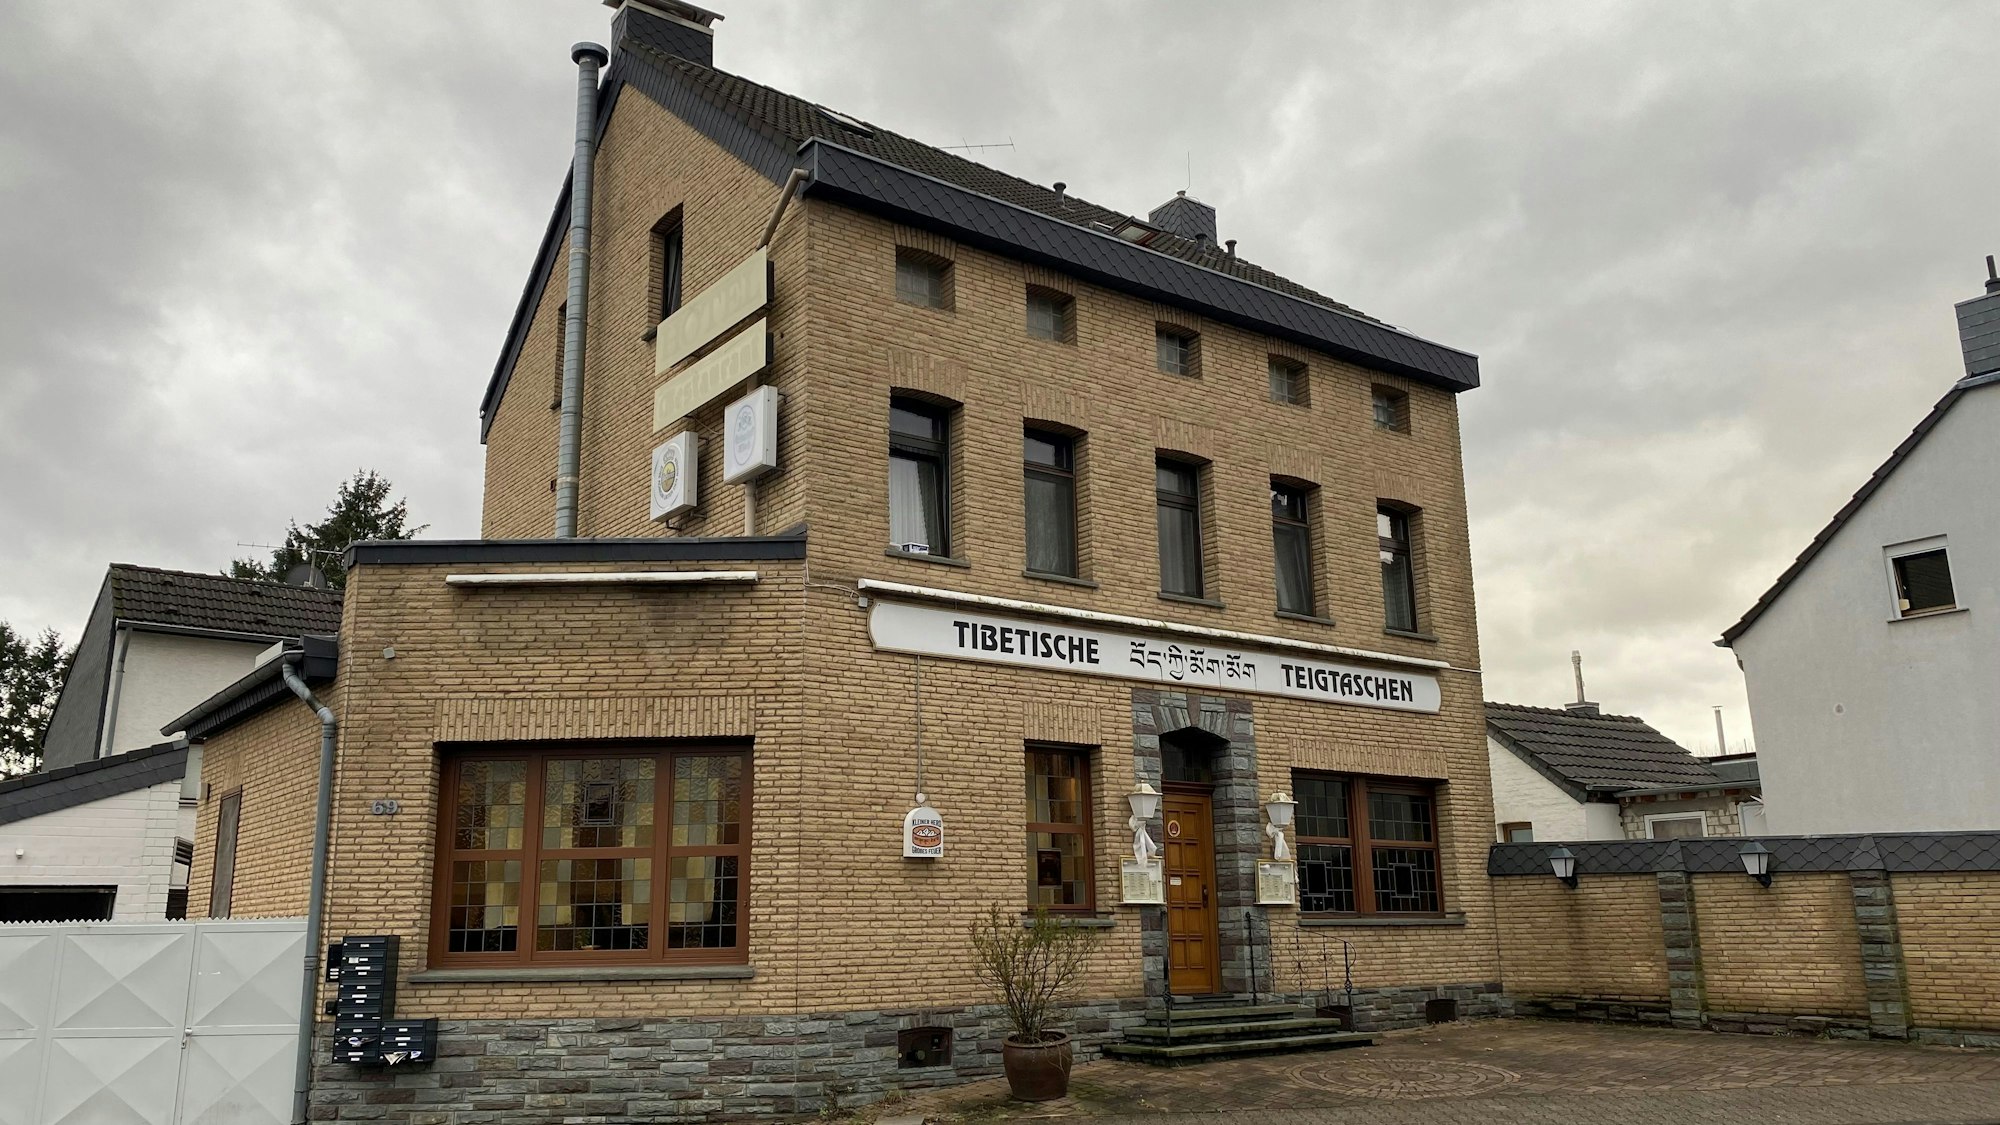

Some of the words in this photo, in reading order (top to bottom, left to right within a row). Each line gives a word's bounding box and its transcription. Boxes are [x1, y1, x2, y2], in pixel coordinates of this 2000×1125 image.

[953, 620, 1100, 664] TIBETISCHE
[1280, 664, 1413, 702] TEIGTASCHEN
[372, 799, 398, 815] 69
